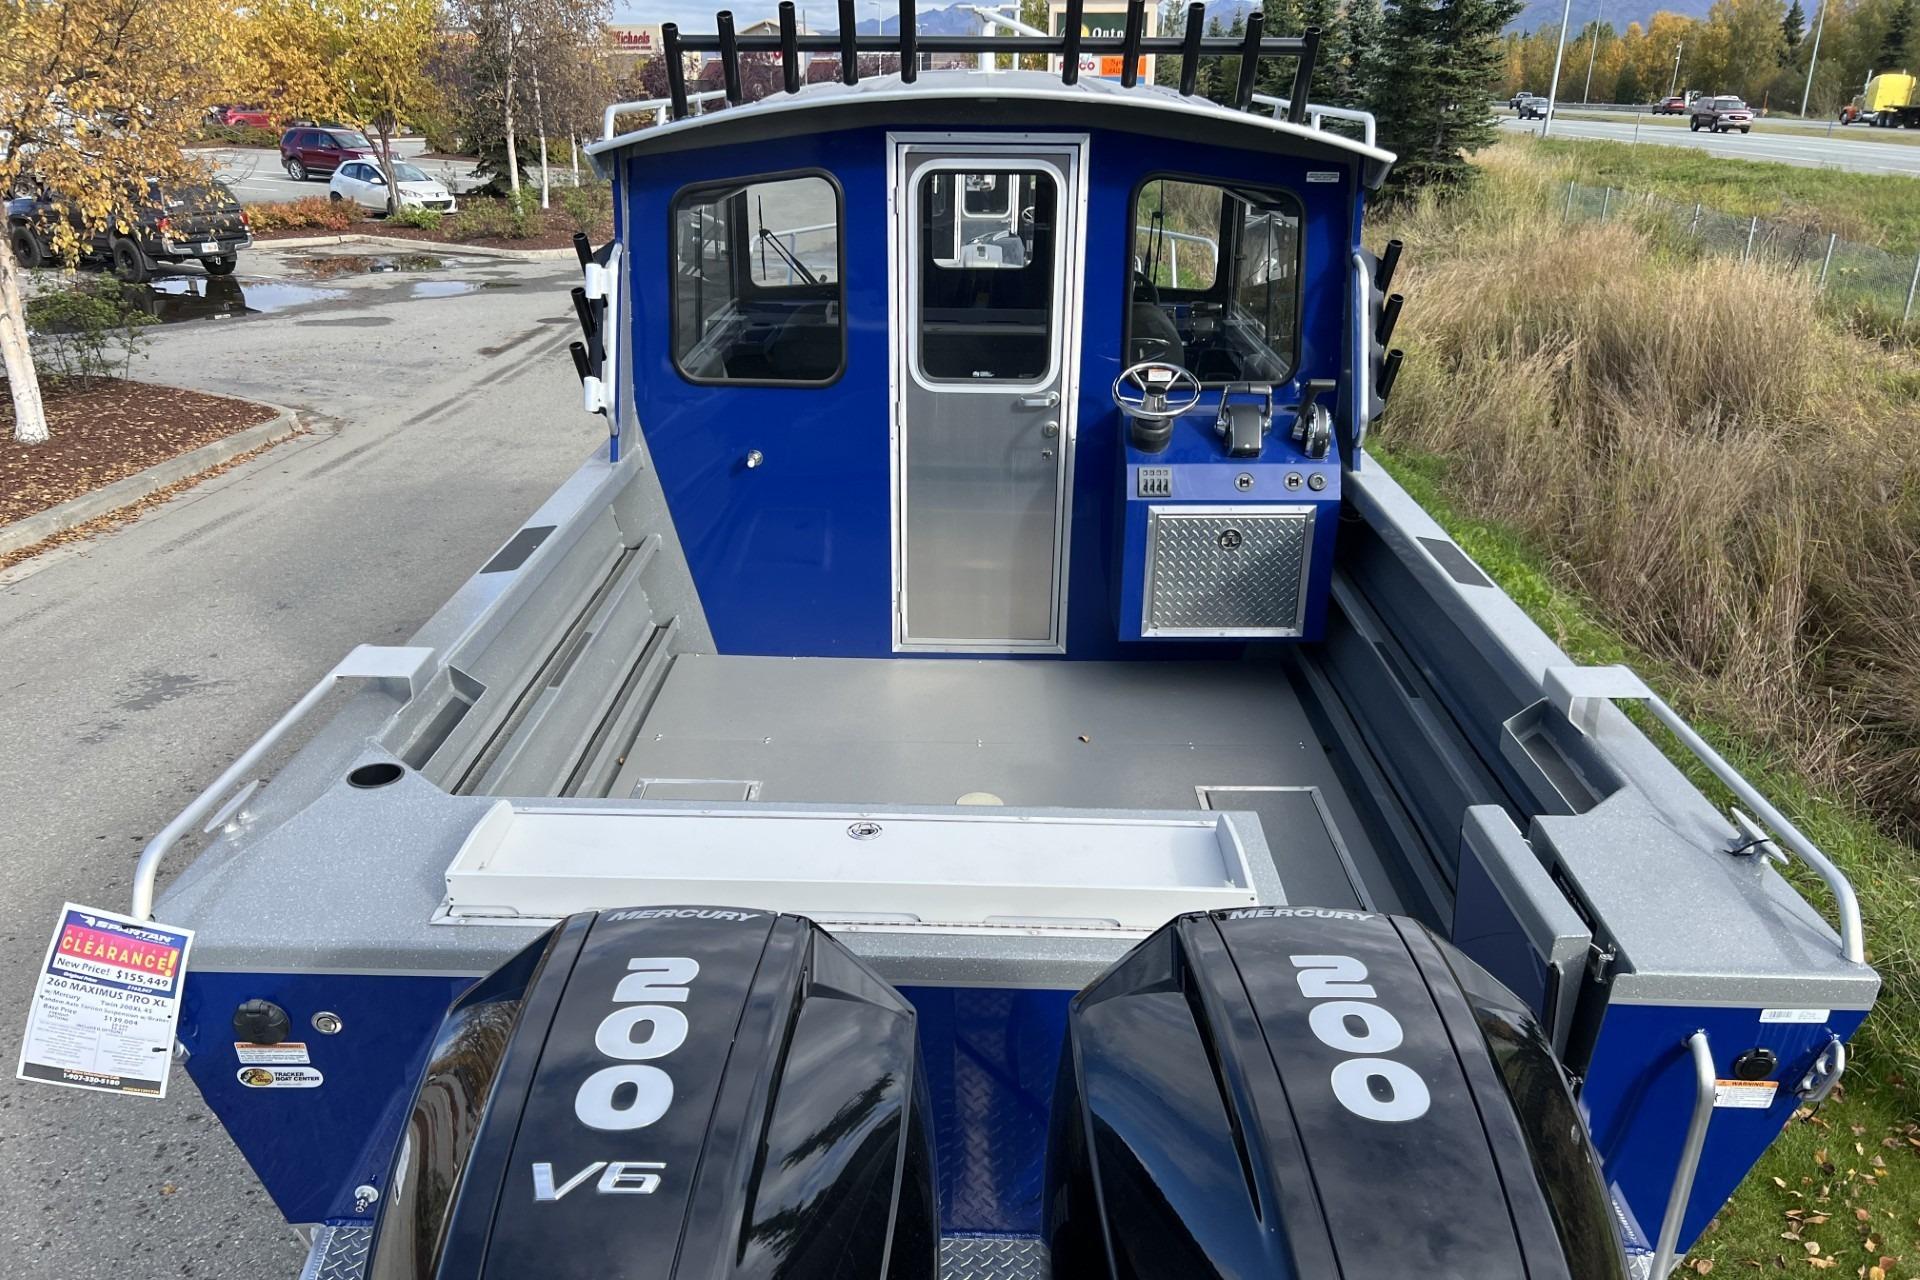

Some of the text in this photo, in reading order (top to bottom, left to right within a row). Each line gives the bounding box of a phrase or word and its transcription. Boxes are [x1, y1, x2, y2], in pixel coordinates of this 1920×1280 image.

[608, 907, 761, 923] MERCURY
[1229, 908, 1374, 922] MERCURY
[62, 936, 178, 976] CLEARANCE!
[56, 957, 168, 988] New Price! $155,449
[46, 976, 167, 1007] 260 MAXIMUS PRO XL
[52, 990, 81, 1001] Mercury
[574, 957, 700, 1131] 200
[1289, 955, 1431, 1122] 200
[531, 1161, 667, 1202] V6
